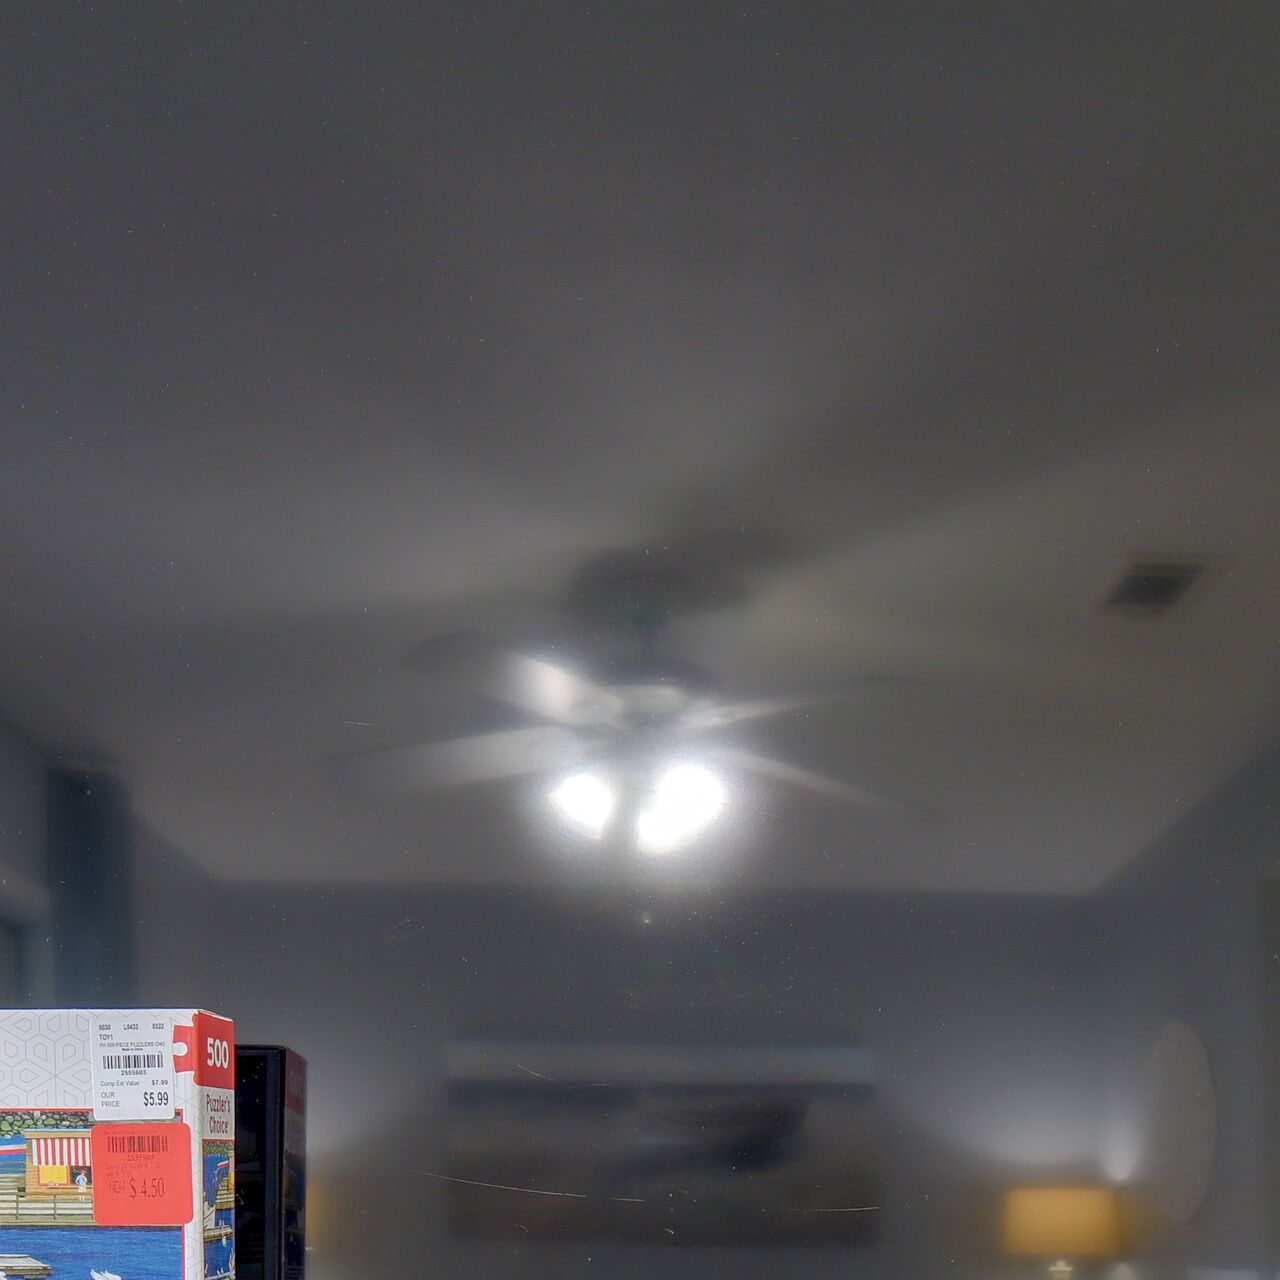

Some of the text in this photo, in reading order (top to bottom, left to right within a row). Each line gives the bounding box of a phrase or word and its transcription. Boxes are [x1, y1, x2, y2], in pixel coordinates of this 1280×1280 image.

[207, 1037, 229, 1069] 500
[144, 1091, 168, 1107] $5.99
[140, 1177, 165, 1198] 4.50
